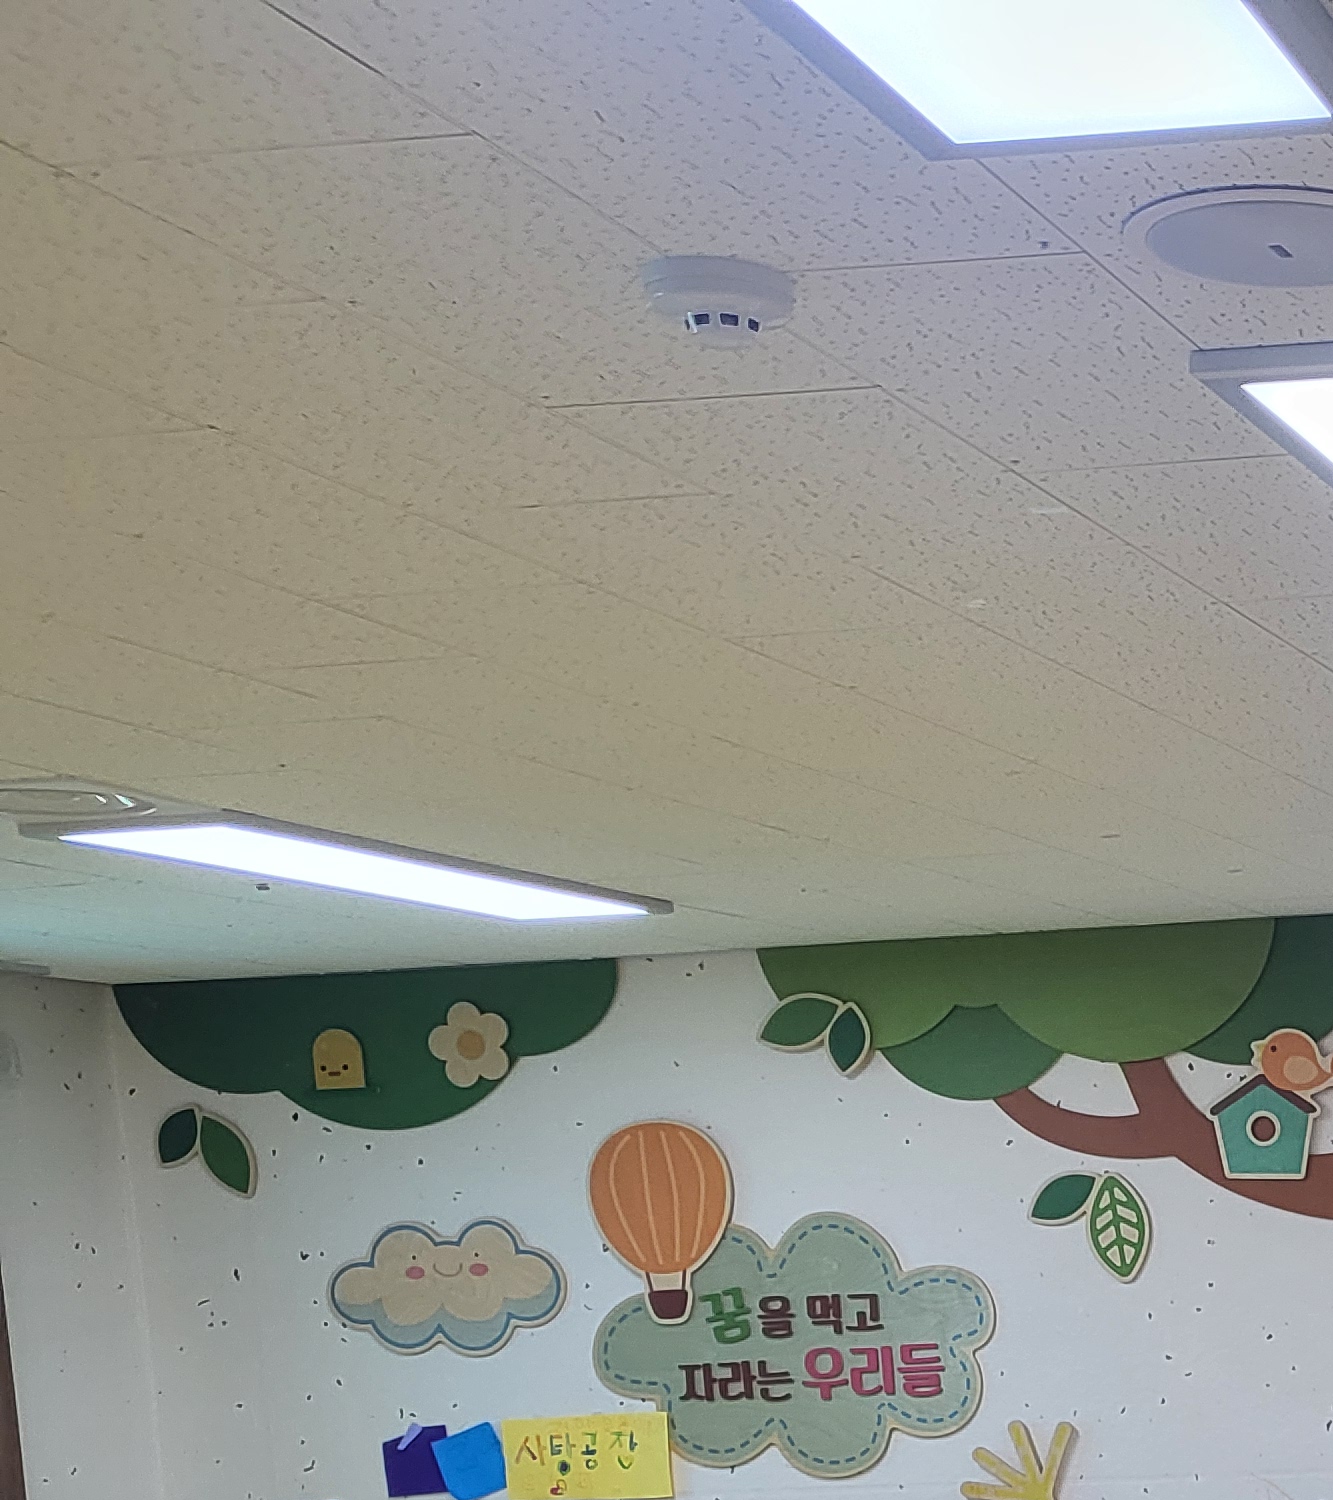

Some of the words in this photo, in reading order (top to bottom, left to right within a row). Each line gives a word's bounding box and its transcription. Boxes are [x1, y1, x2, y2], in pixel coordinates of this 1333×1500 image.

[700, 1286, 796, 1344] 꿈을
[806, 1293, 884, 1335] 먹고
[678, 1360, 795, 1402] 자라는
[802, 1343, 945, 1401] 우리들
[514, 1430, 639, 1476] 사탕공장
